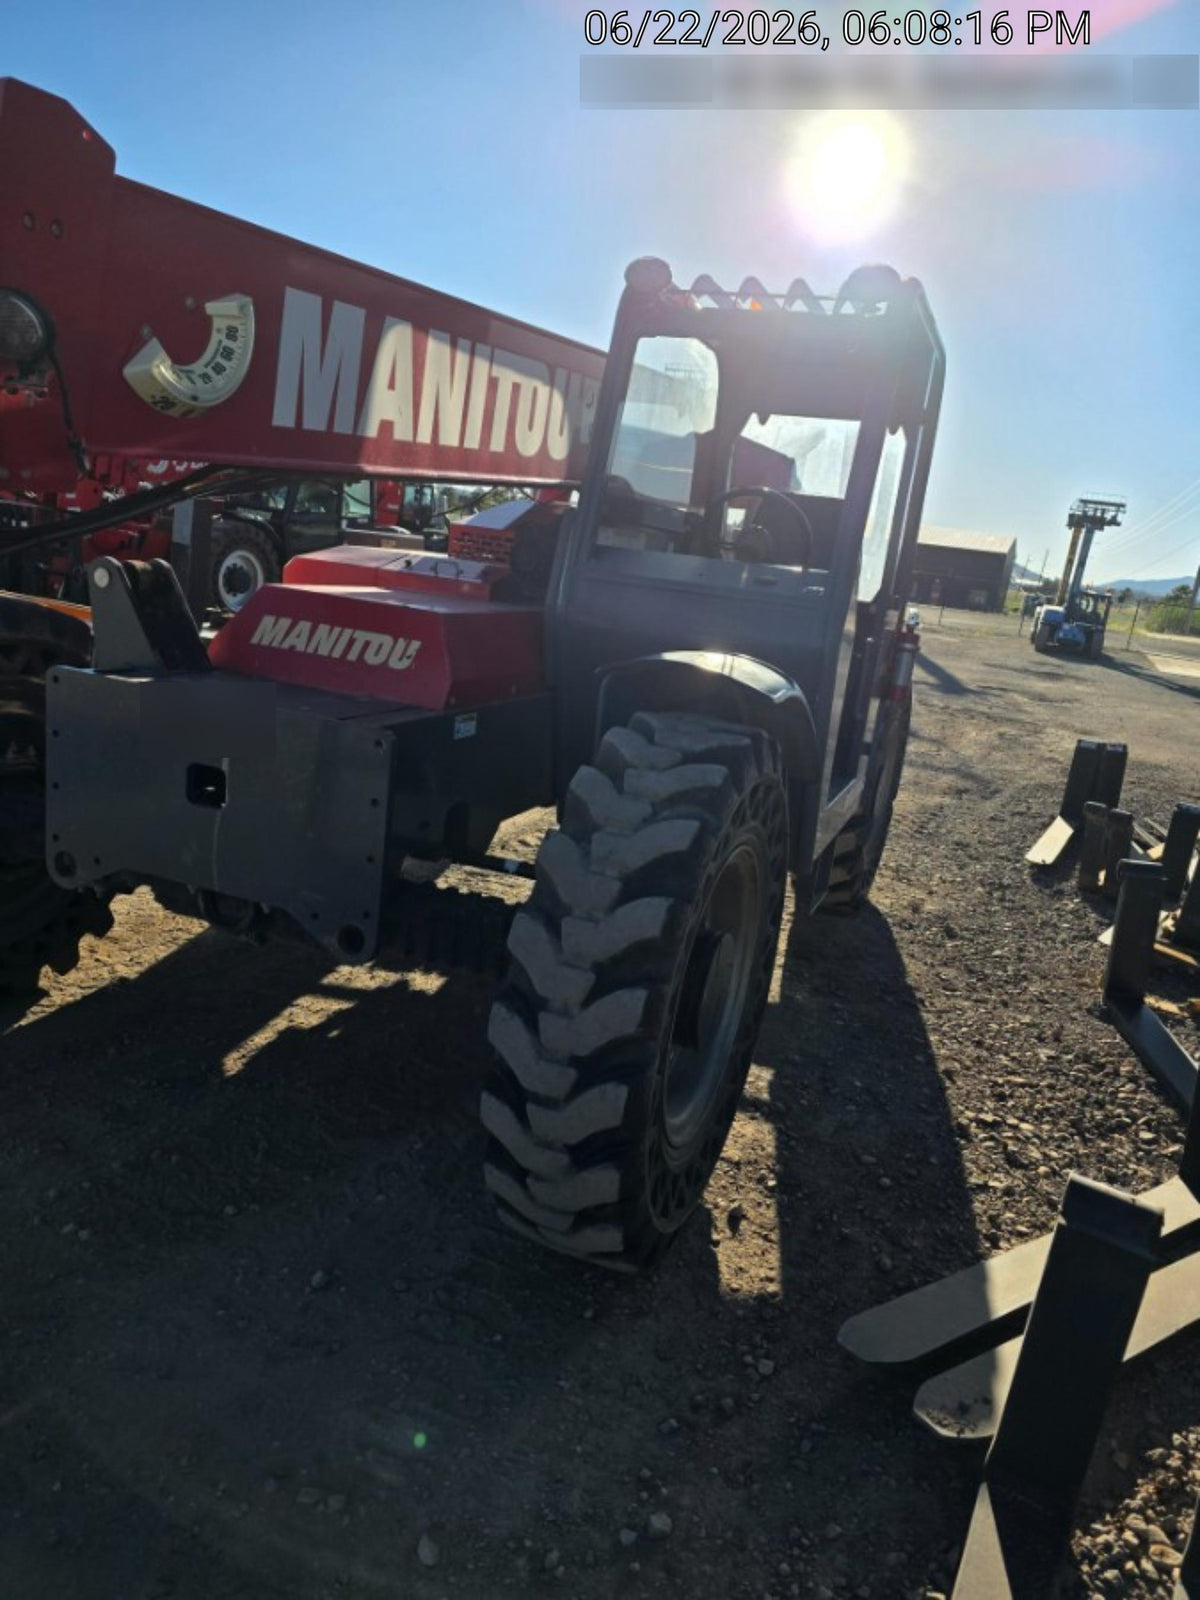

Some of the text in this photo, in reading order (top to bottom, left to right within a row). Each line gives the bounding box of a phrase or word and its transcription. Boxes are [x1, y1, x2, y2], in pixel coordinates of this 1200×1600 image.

[225, 325, 239, 342] 80
[220, 345, 236, 361] 60
[271, 285, 583, 460] MANITOU
[250, 615, 422, 669] MANITOU
